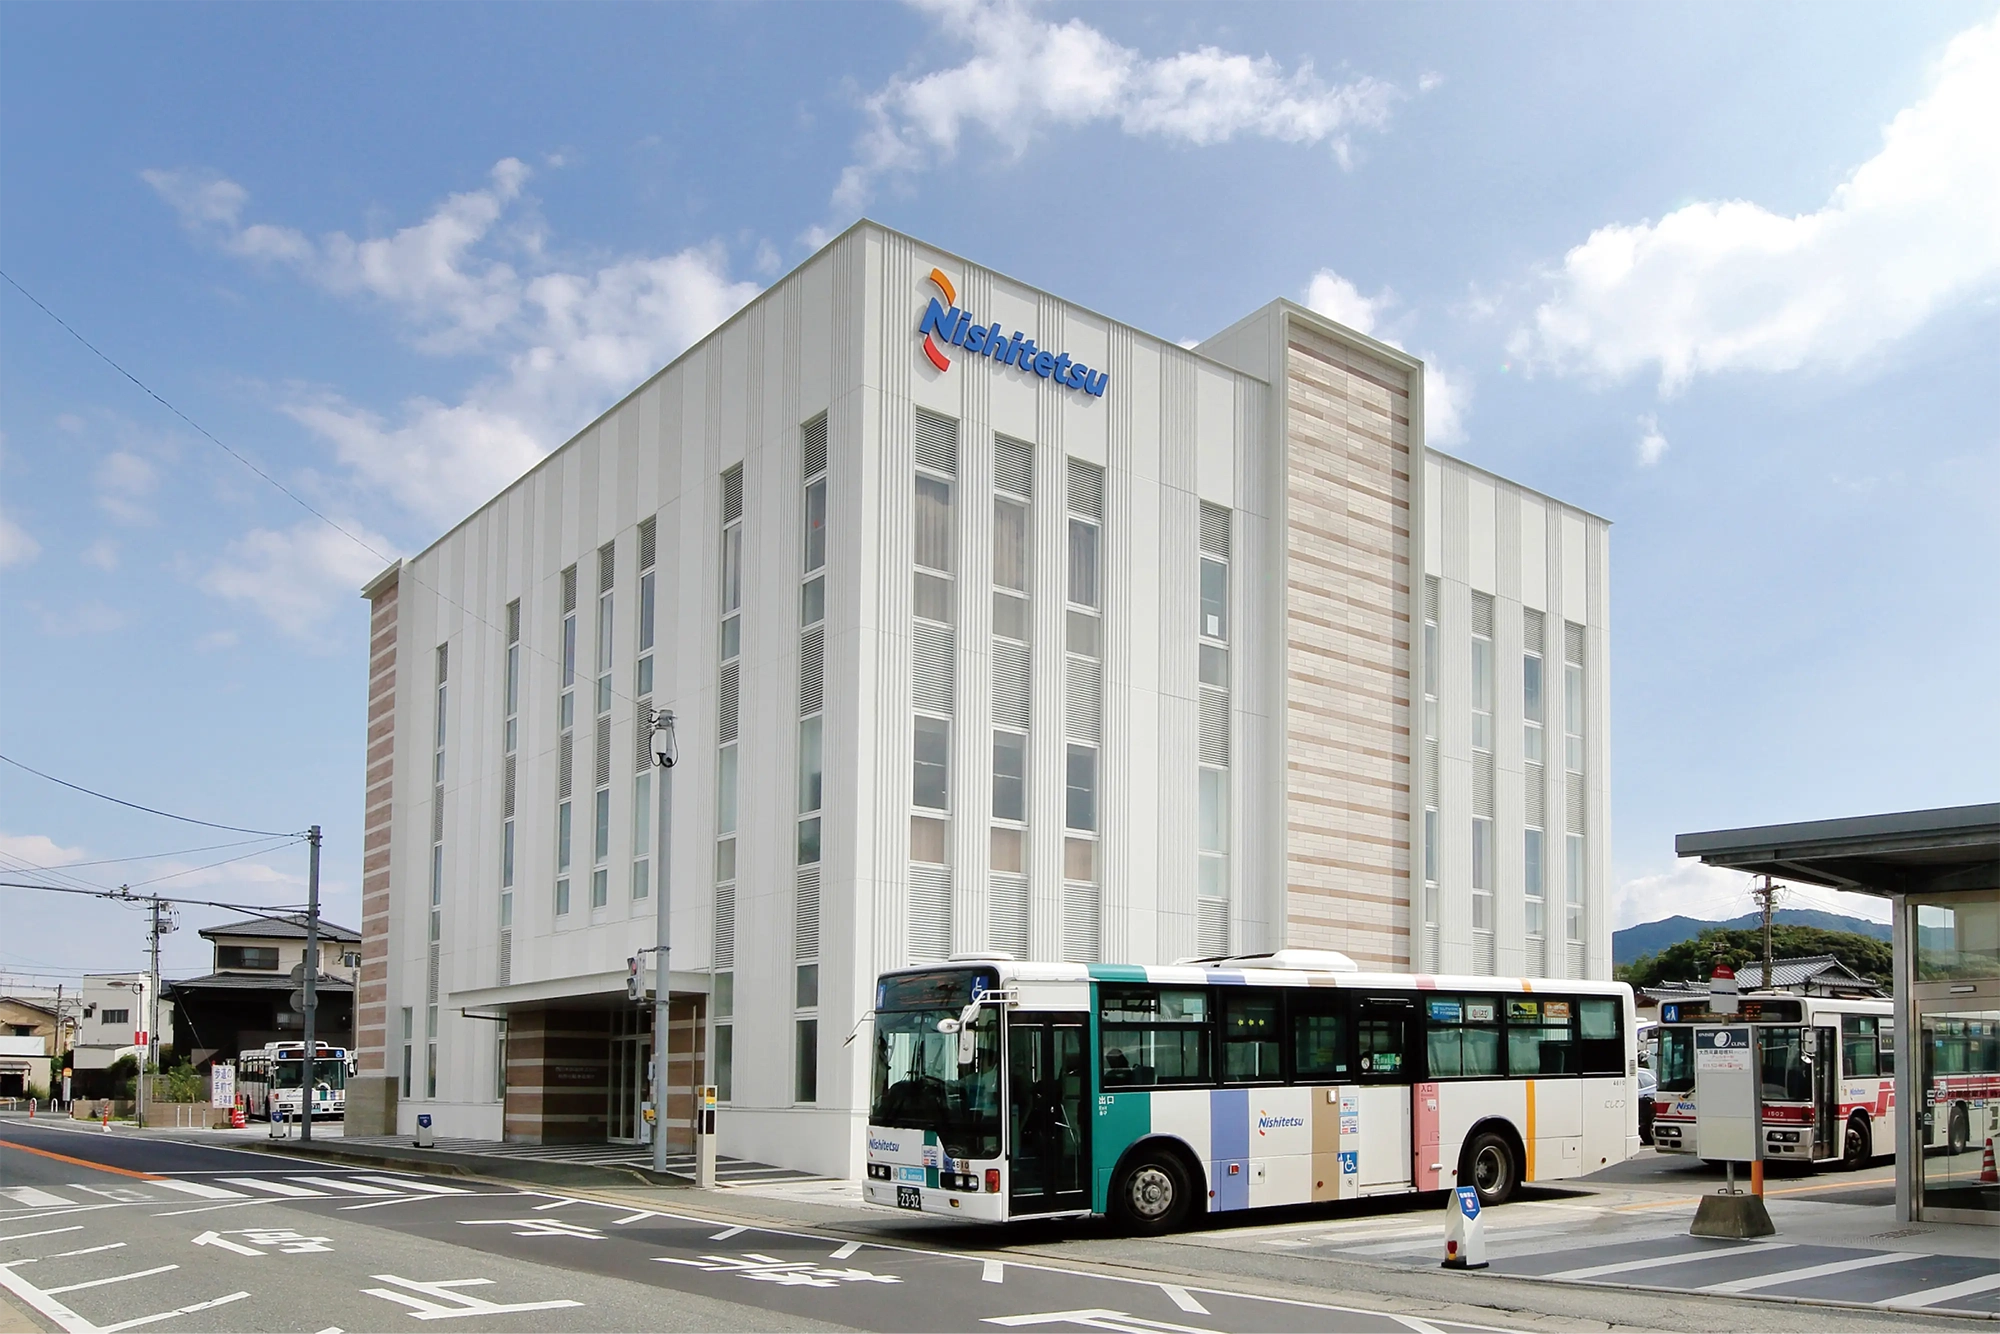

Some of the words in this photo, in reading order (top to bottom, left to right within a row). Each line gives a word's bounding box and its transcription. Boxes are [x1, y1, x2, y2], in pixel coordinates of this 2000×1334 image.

[919, 297, 1109, 397] Nishitetsu
[1099, 1096, 1115, 1104] 出口
[1258, 1116, 1304, 1128] Nishitetsu
[869, 1139, 899, 1152] Nishitetsu
[900, 1193, 920, 1208] 23-92
